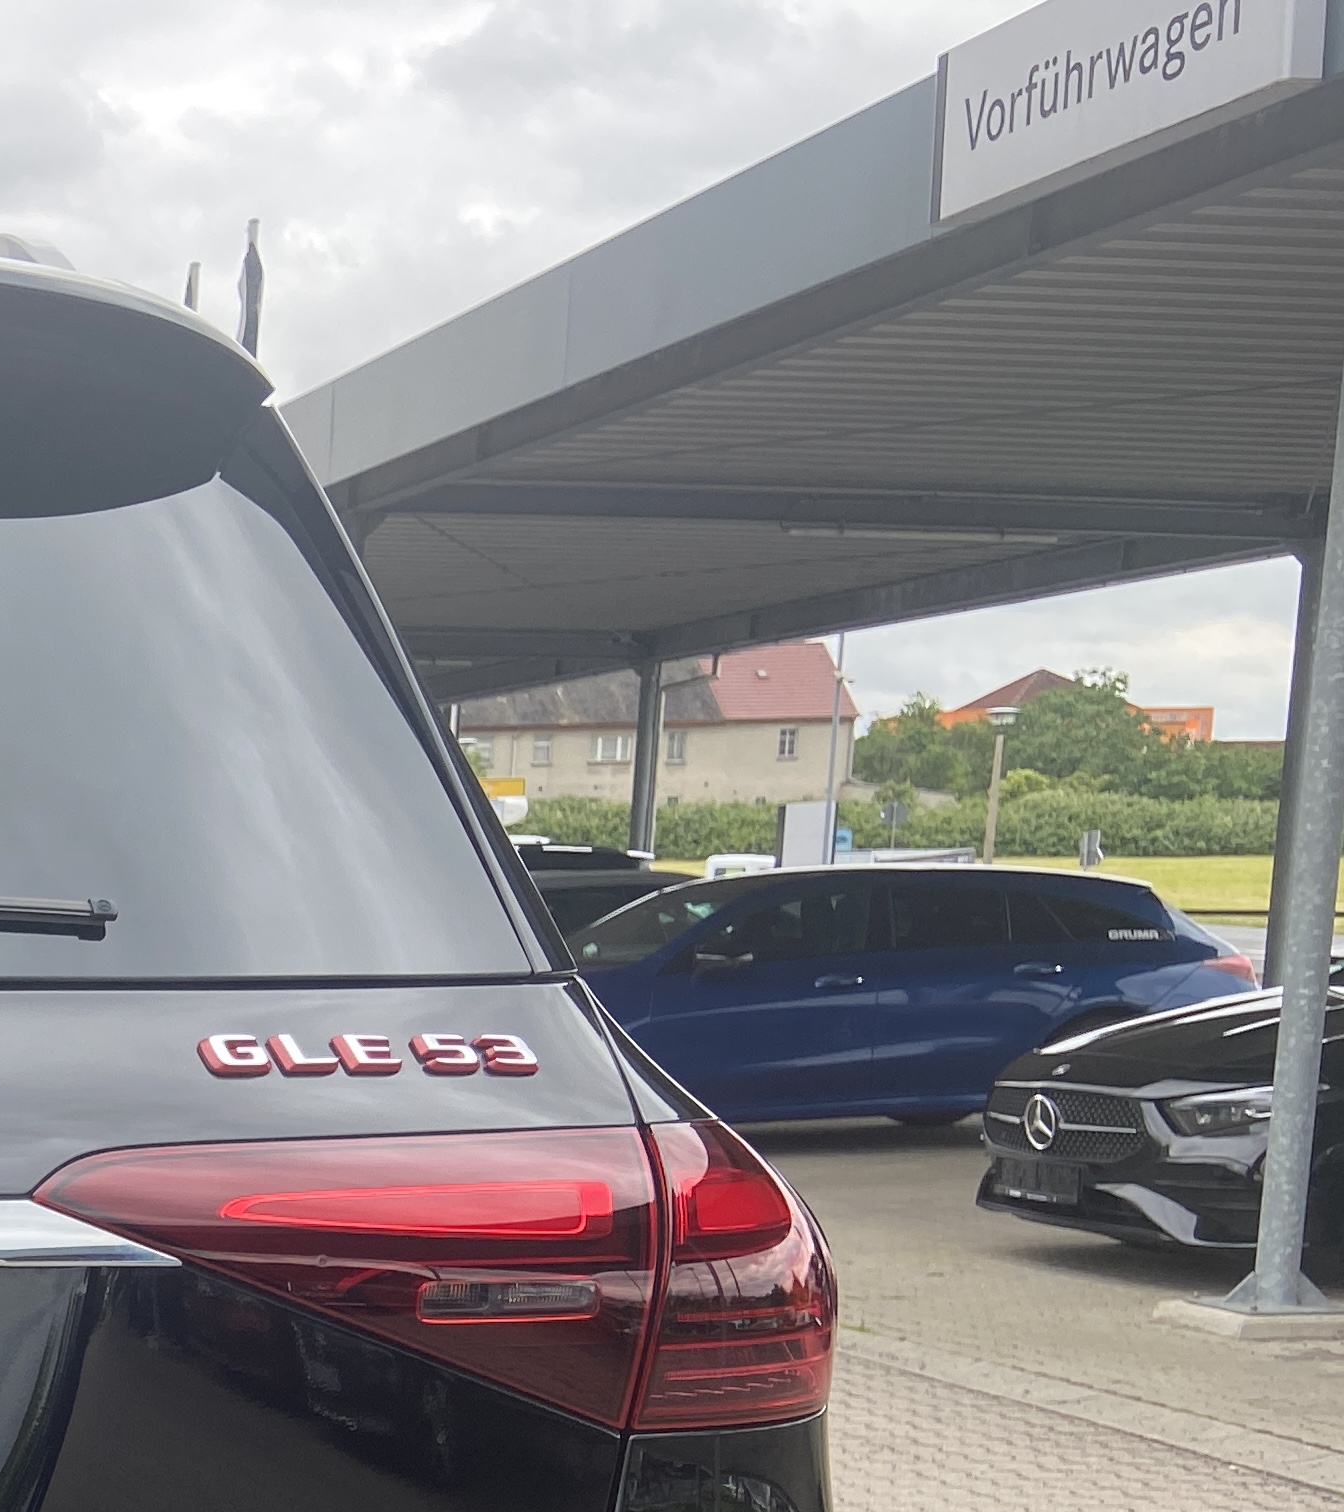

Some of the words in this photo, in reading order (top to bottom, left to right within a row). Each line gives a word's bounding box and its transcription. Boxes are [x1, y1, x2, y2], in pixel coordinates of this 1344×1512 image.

[965, 0, 1241, 151] Vorführwagen
[197, 1033, 403, 1078] GLE
[409, 1033, 539, 1078] 53
